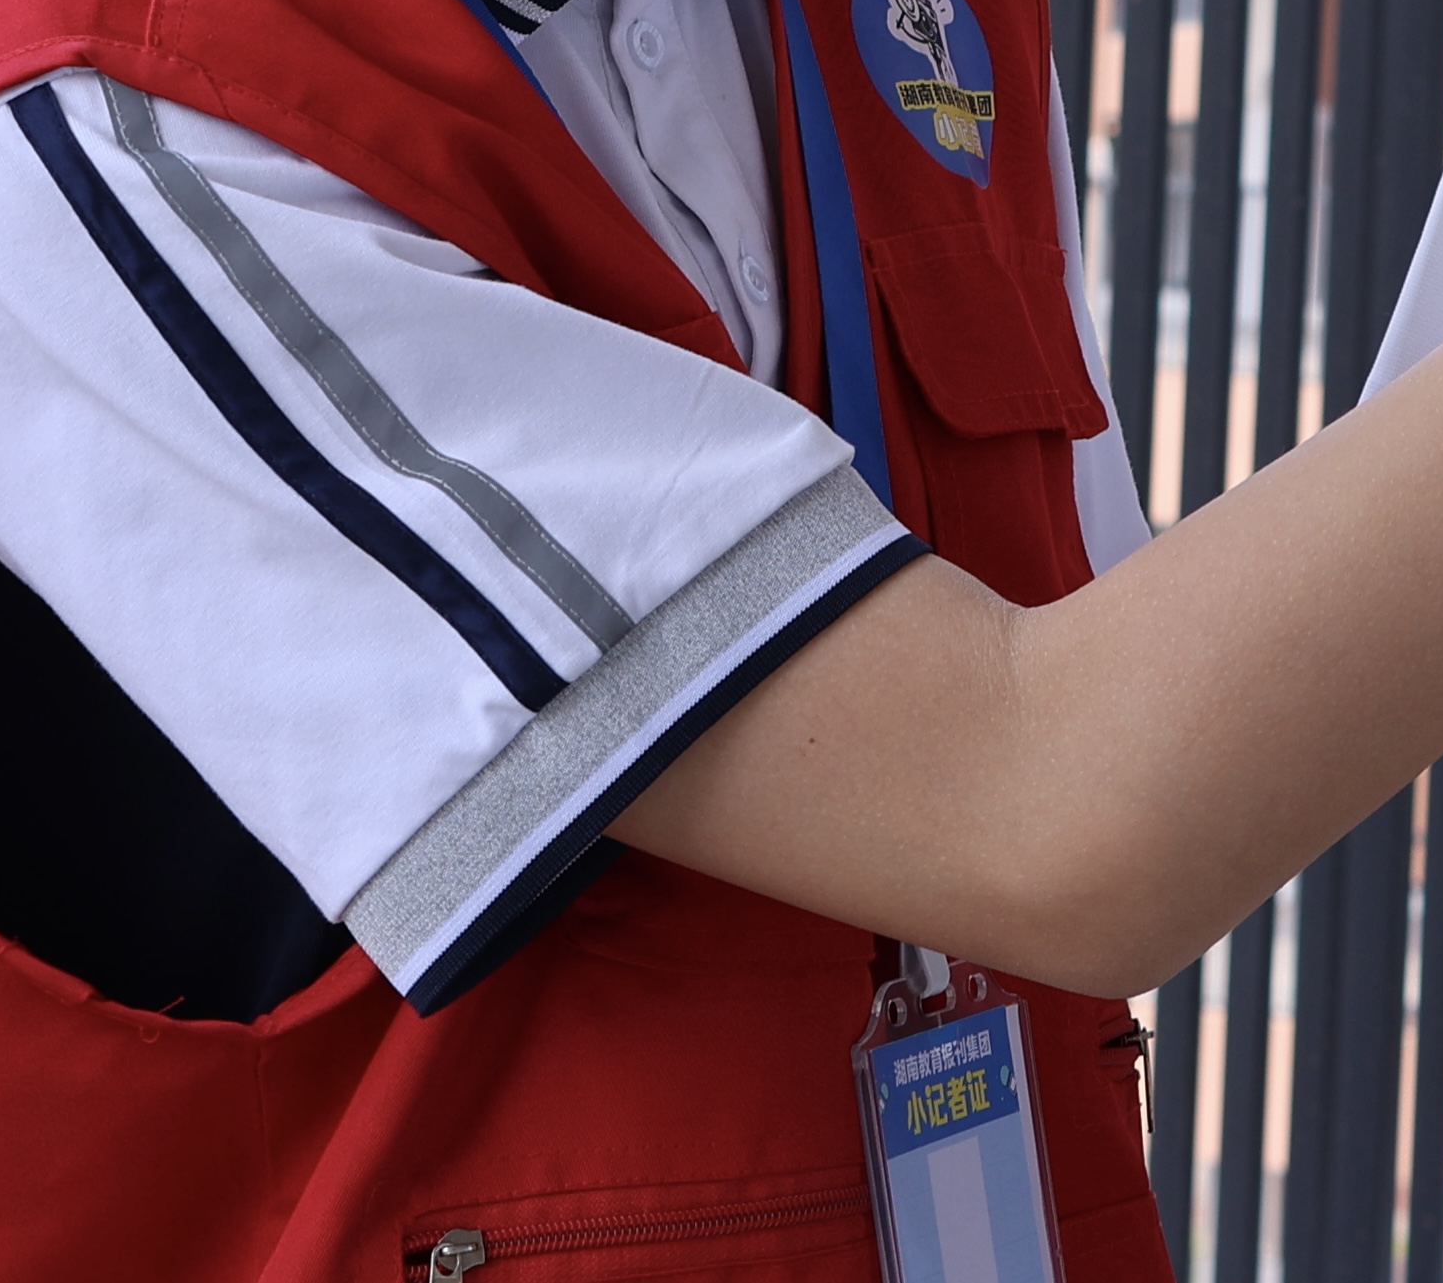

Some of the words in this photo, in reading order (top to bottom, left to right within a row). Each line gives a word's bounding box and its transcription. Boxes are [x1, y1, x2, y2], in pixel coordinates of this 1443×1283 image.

[894, 1030, 992, 1087] 湖南教育报刊集团
[907, 1069, 991, 1135] 小记者证
